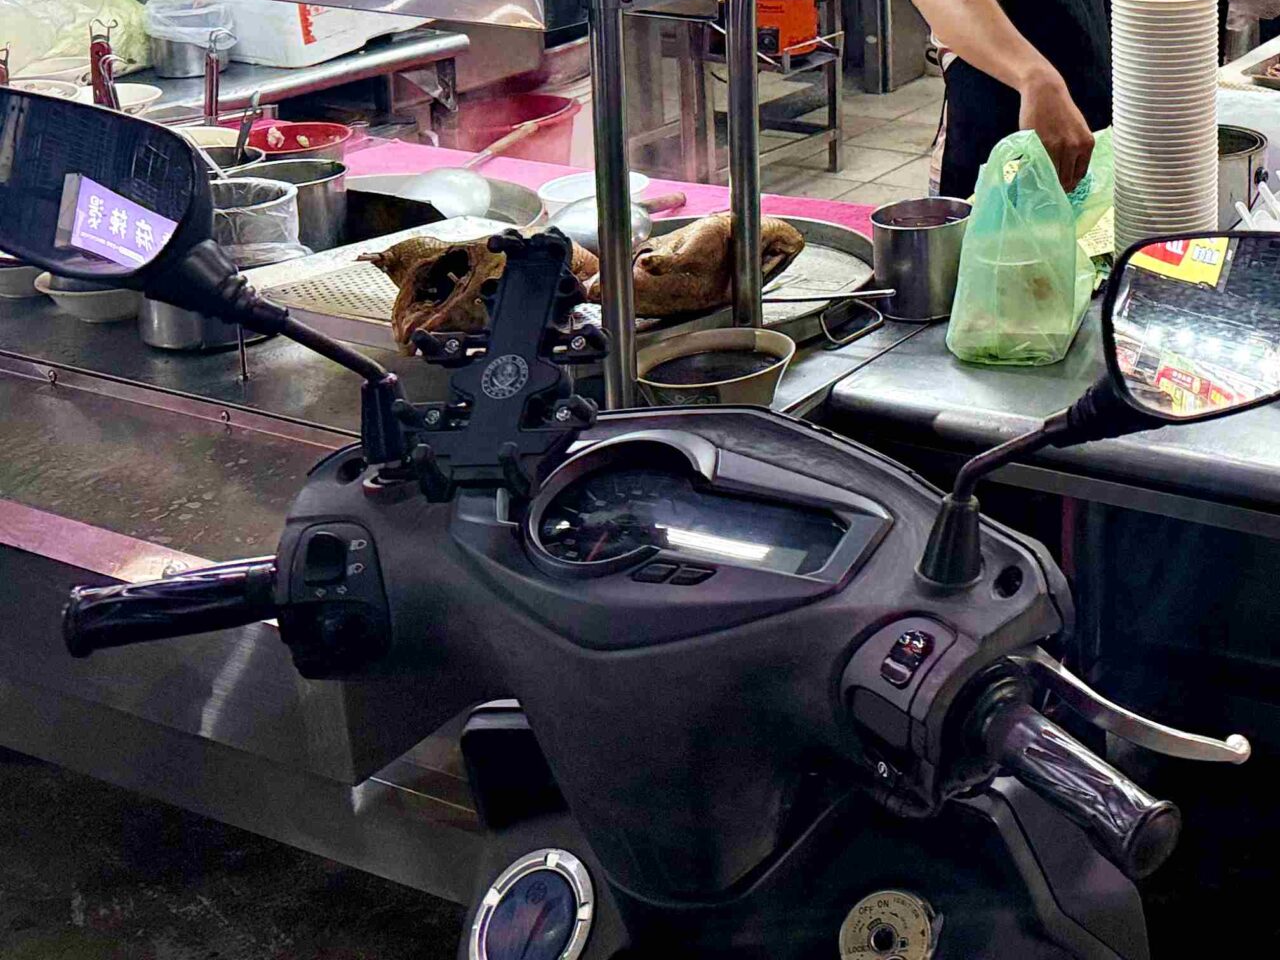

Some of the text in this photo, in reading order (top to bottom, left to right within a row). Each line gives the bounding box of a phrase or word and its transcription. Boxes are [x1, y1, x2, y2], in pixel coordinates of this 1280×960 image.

[878, 900, 889, 908] ON
[859, 906, 874, 915] OFF
[848, 945, 870, 954] LOCK
